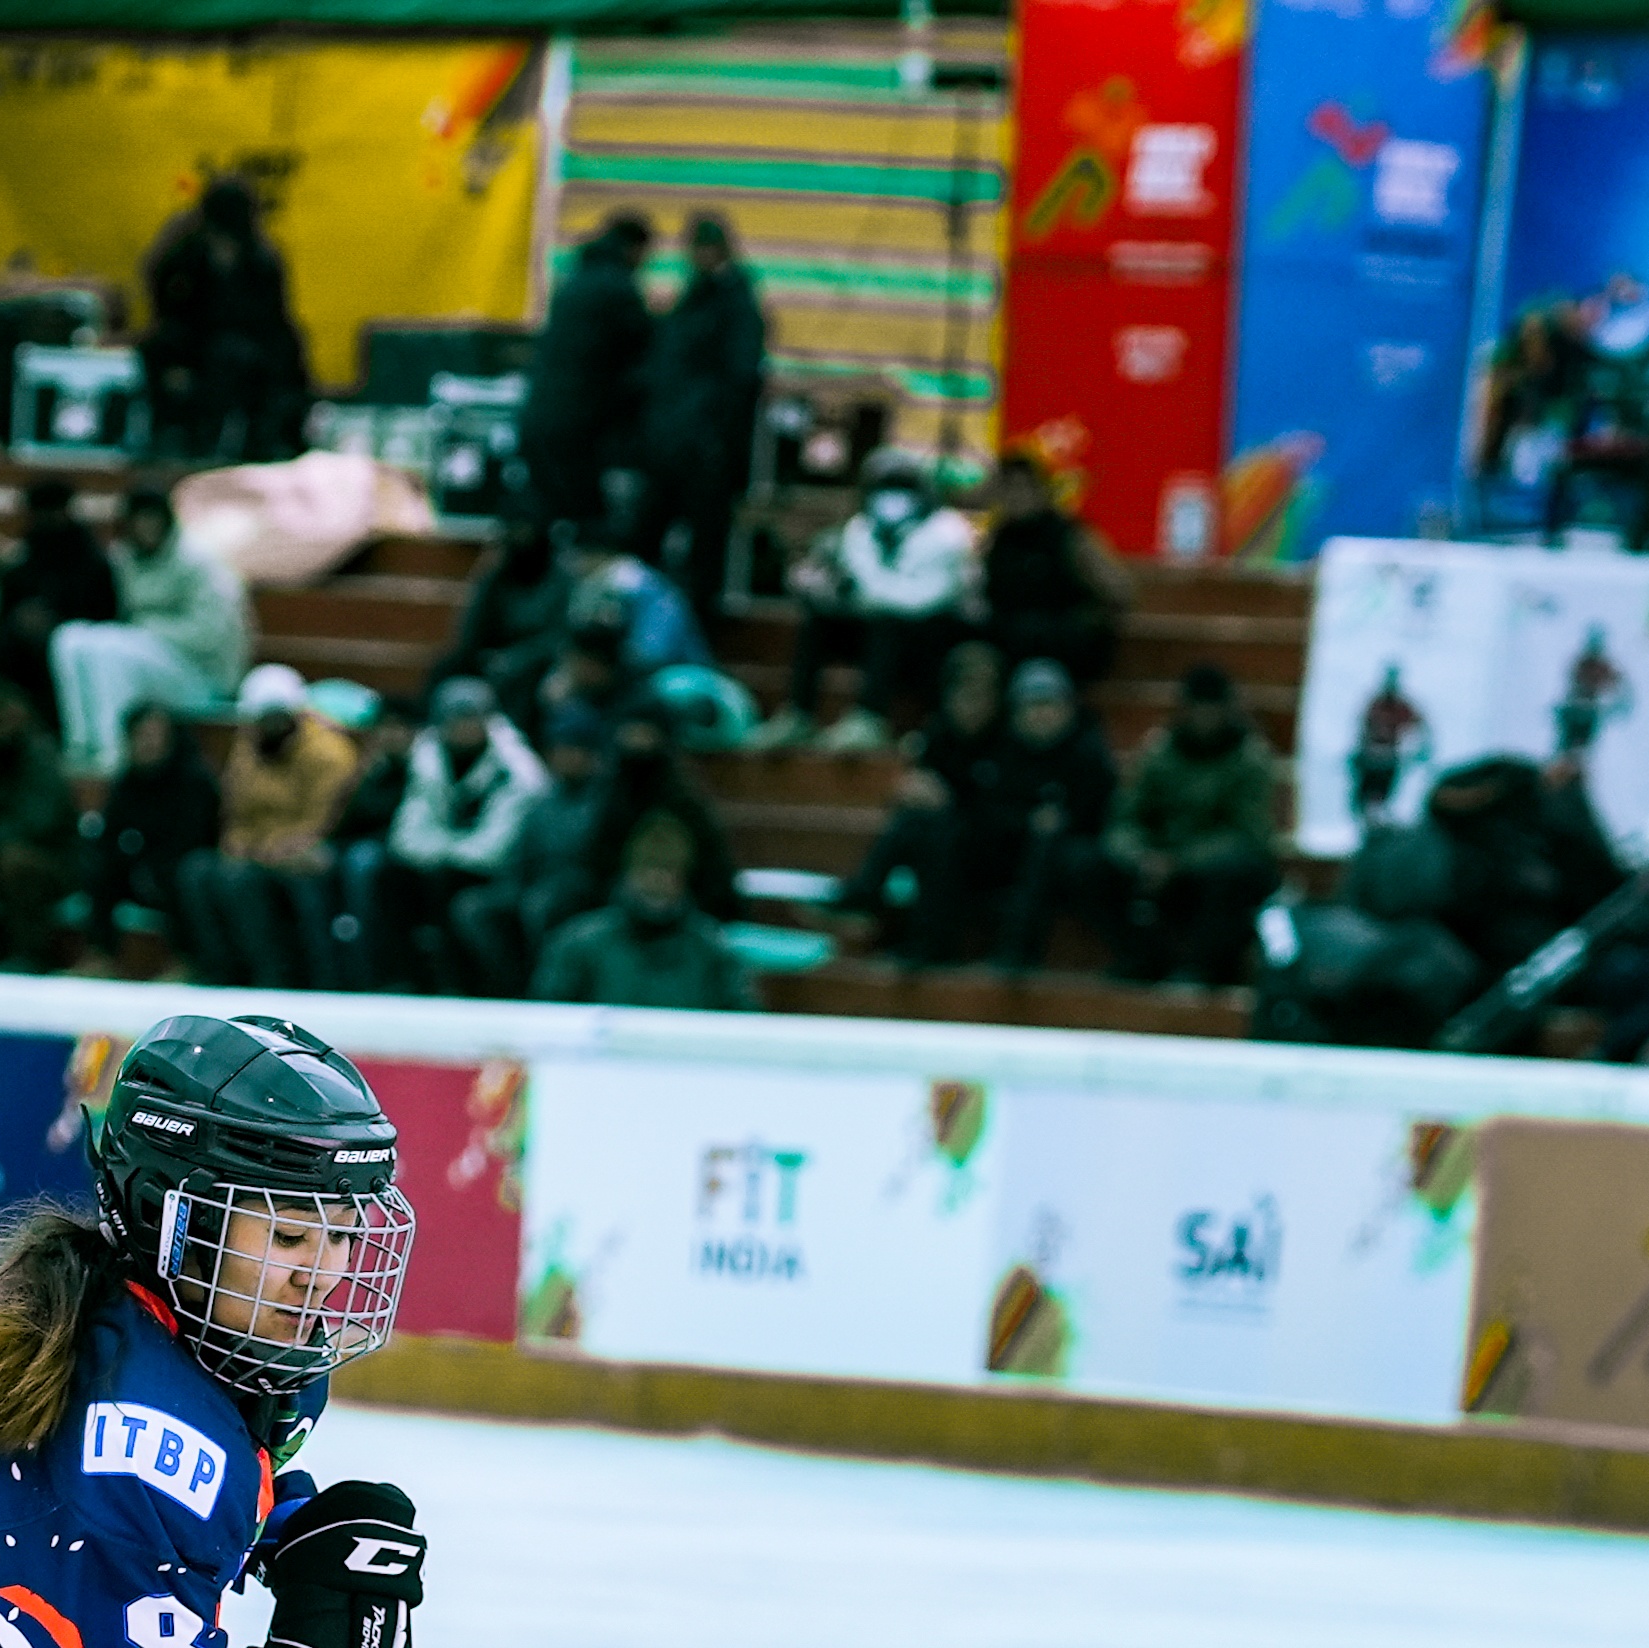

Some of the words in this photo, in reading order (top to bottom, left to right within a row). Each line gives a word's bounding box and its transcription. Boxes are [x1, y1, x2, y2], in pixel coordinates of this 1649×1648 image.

[132, 1110, 196, 1138] BAUER
[333, 1148, 391, 1164] BAUER
[698, 1140, 808, 1224] FIT
[93, 1415, 216, 1494] ITBP
[343, 1536, 426, 1578] C
